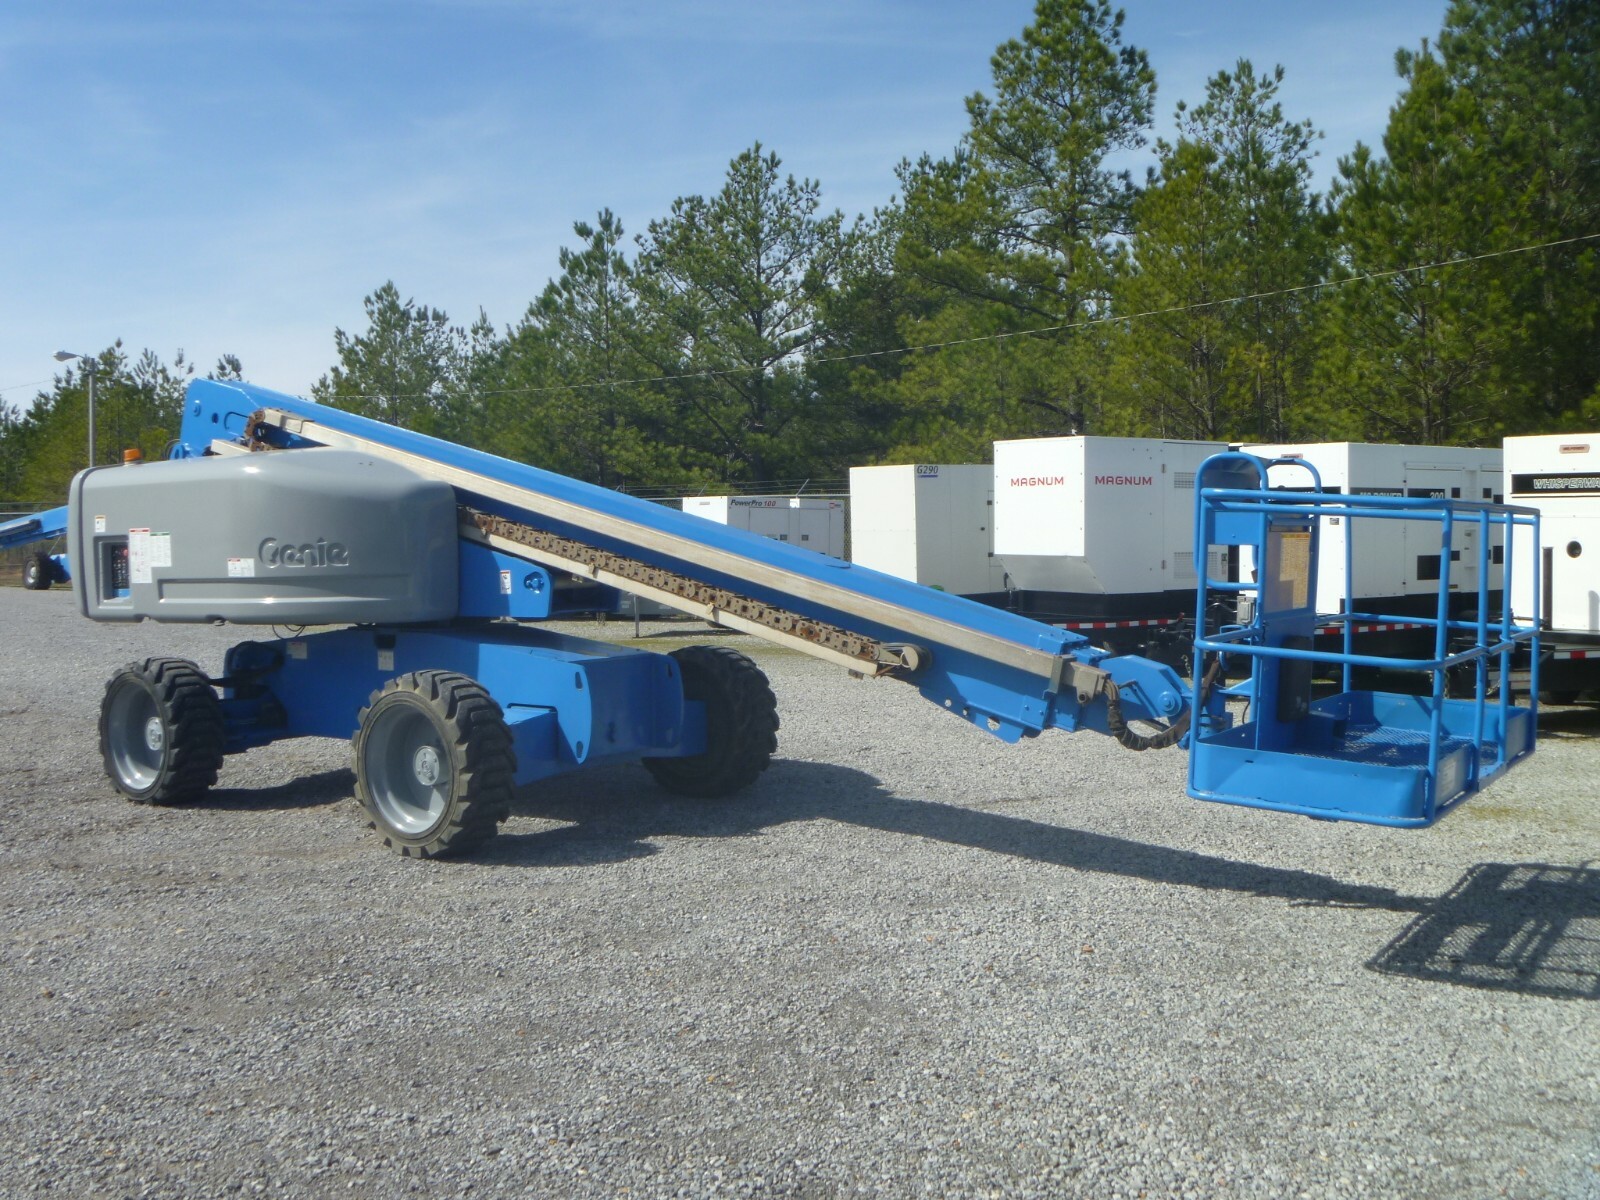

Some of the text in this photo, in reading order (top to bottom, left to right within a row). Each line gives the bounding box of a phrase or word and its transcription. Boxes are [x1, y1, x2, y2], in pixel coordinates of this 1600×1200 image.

[917, 465, 938, 474] G290
[1010, 477, 1064, 487] MAGNUM
[1095, 476, 1152, 486] MAGNUM
[730, 499, 763, 507] PowerPro
[258, 537, 349, 569] Genie
